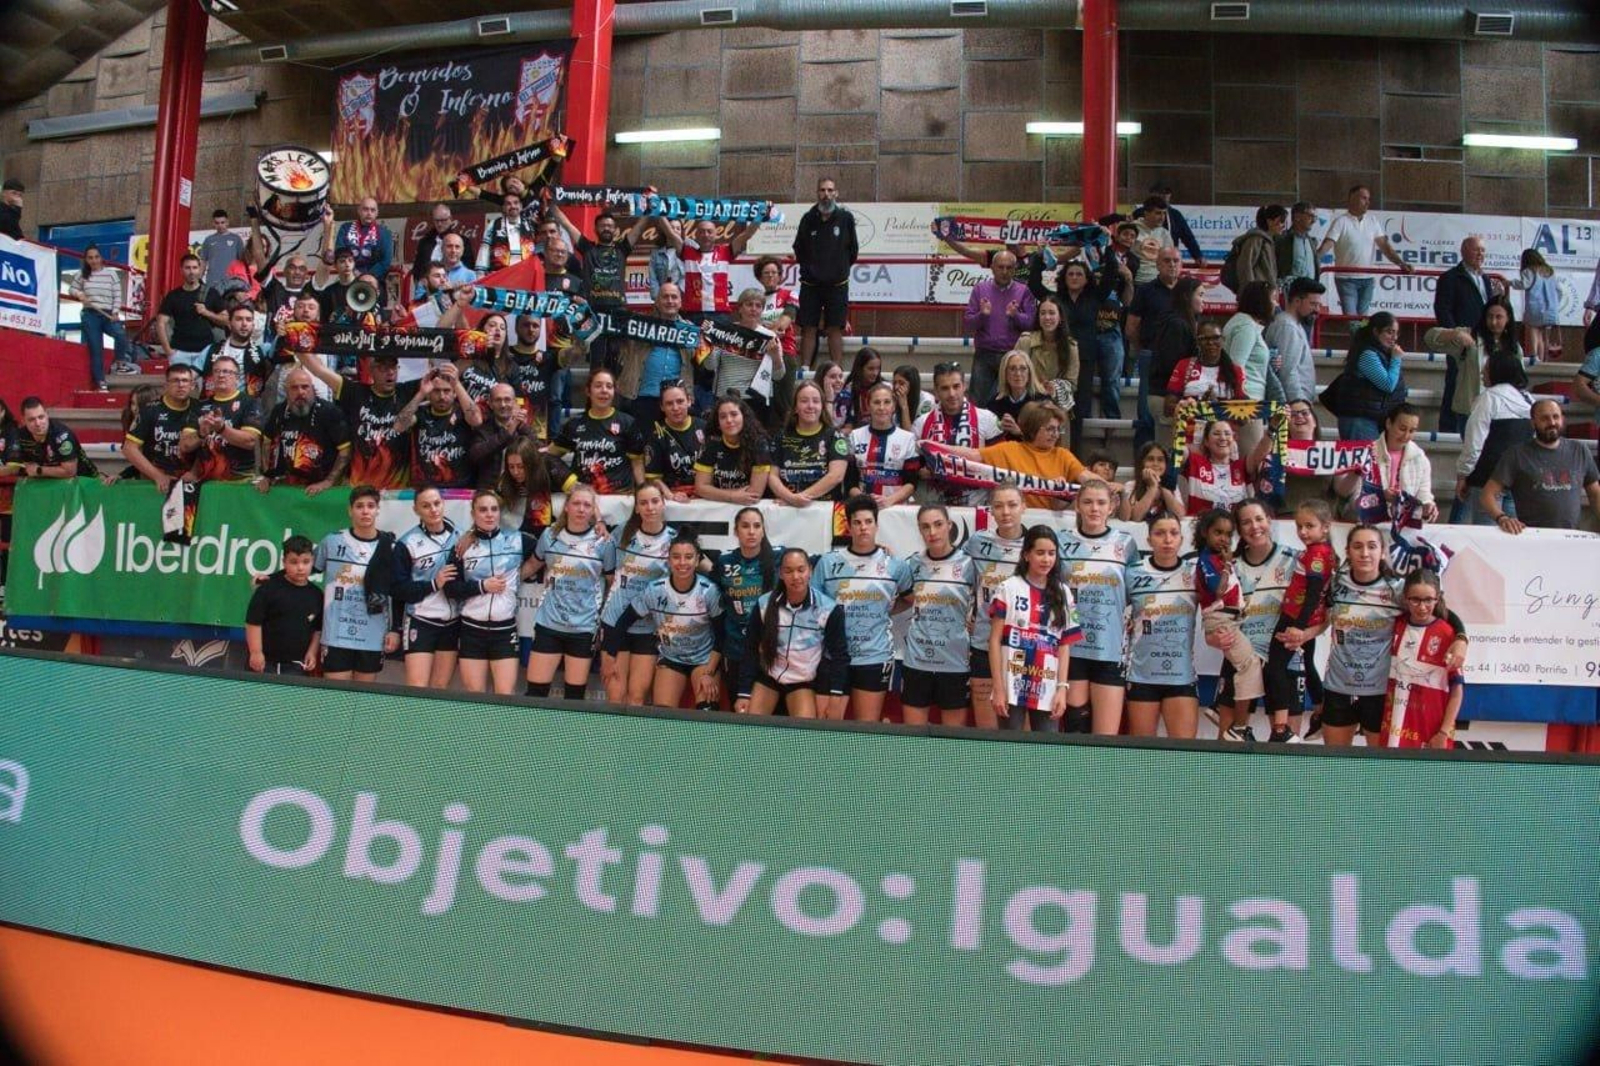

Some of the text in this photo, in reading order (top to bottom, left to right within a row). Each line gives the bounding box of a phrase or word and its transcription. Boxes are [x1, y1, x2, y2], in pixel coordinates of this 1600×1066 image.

[475, 288, 498, 306] TL.
[115, 522, 323, 584] Iberdro
[723, 563, 741, 577] 32
[831, 562, 845, 574] 17
[1133, 576, 1153, 589] 22
[1524, 575, 1600, 620] Sing
[1509, 632, 1521, 643] de
[1523, 635, 1563, 645] entender
[1478, 663, 1490, 672] 44
[1500, 663, 1531, 674] 36400
